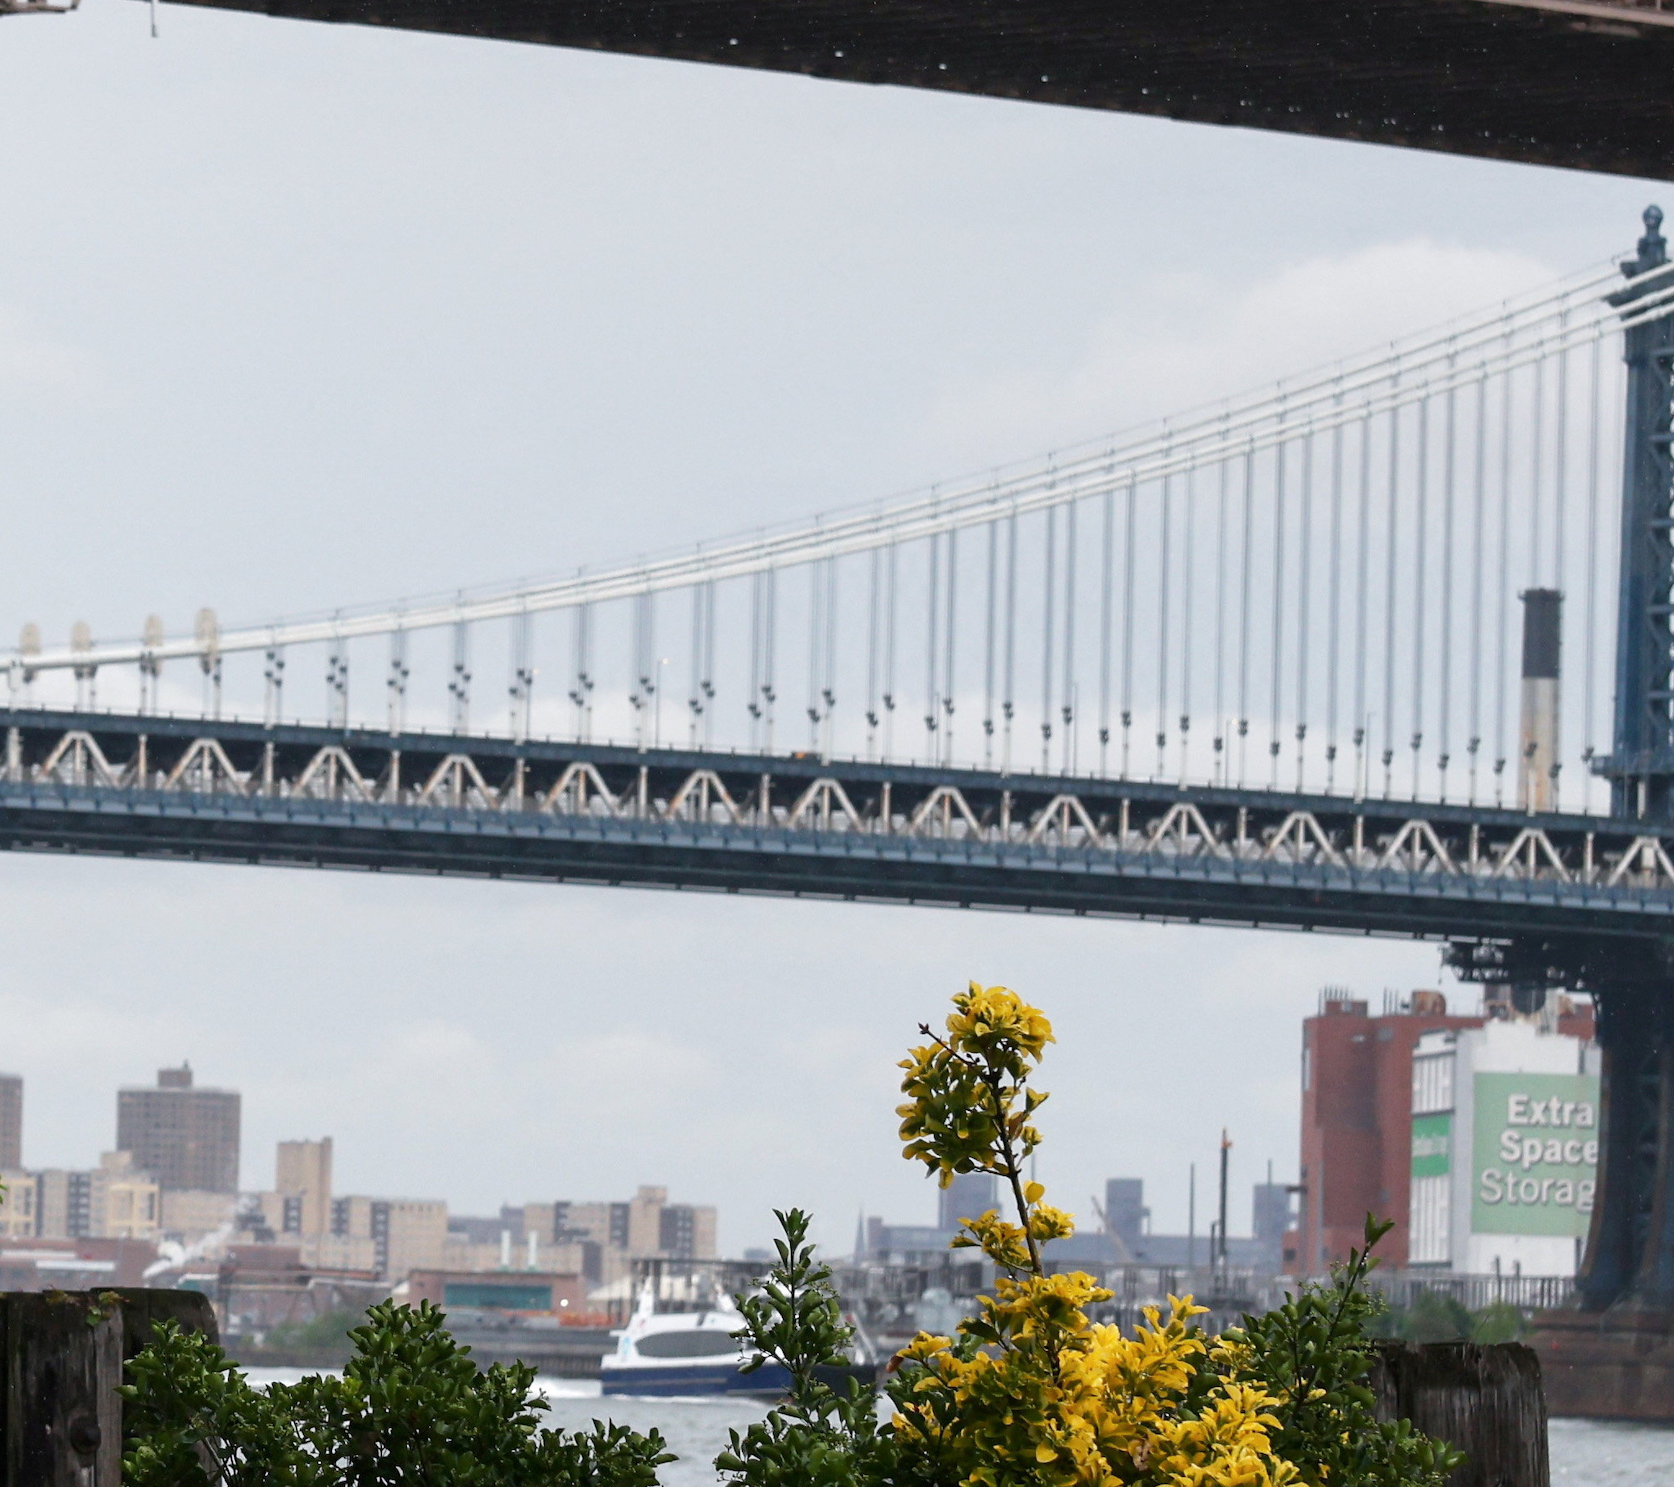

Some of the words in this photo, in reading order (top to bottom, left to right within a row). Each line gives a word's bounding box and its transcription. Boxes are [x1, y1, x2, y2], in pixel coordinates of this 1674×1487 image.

[1508, 1094, 1594, 1128] Extra
[1500, 1130, 1598, 1171] Space
[1481, 1168, 1595, 1212] Storag
